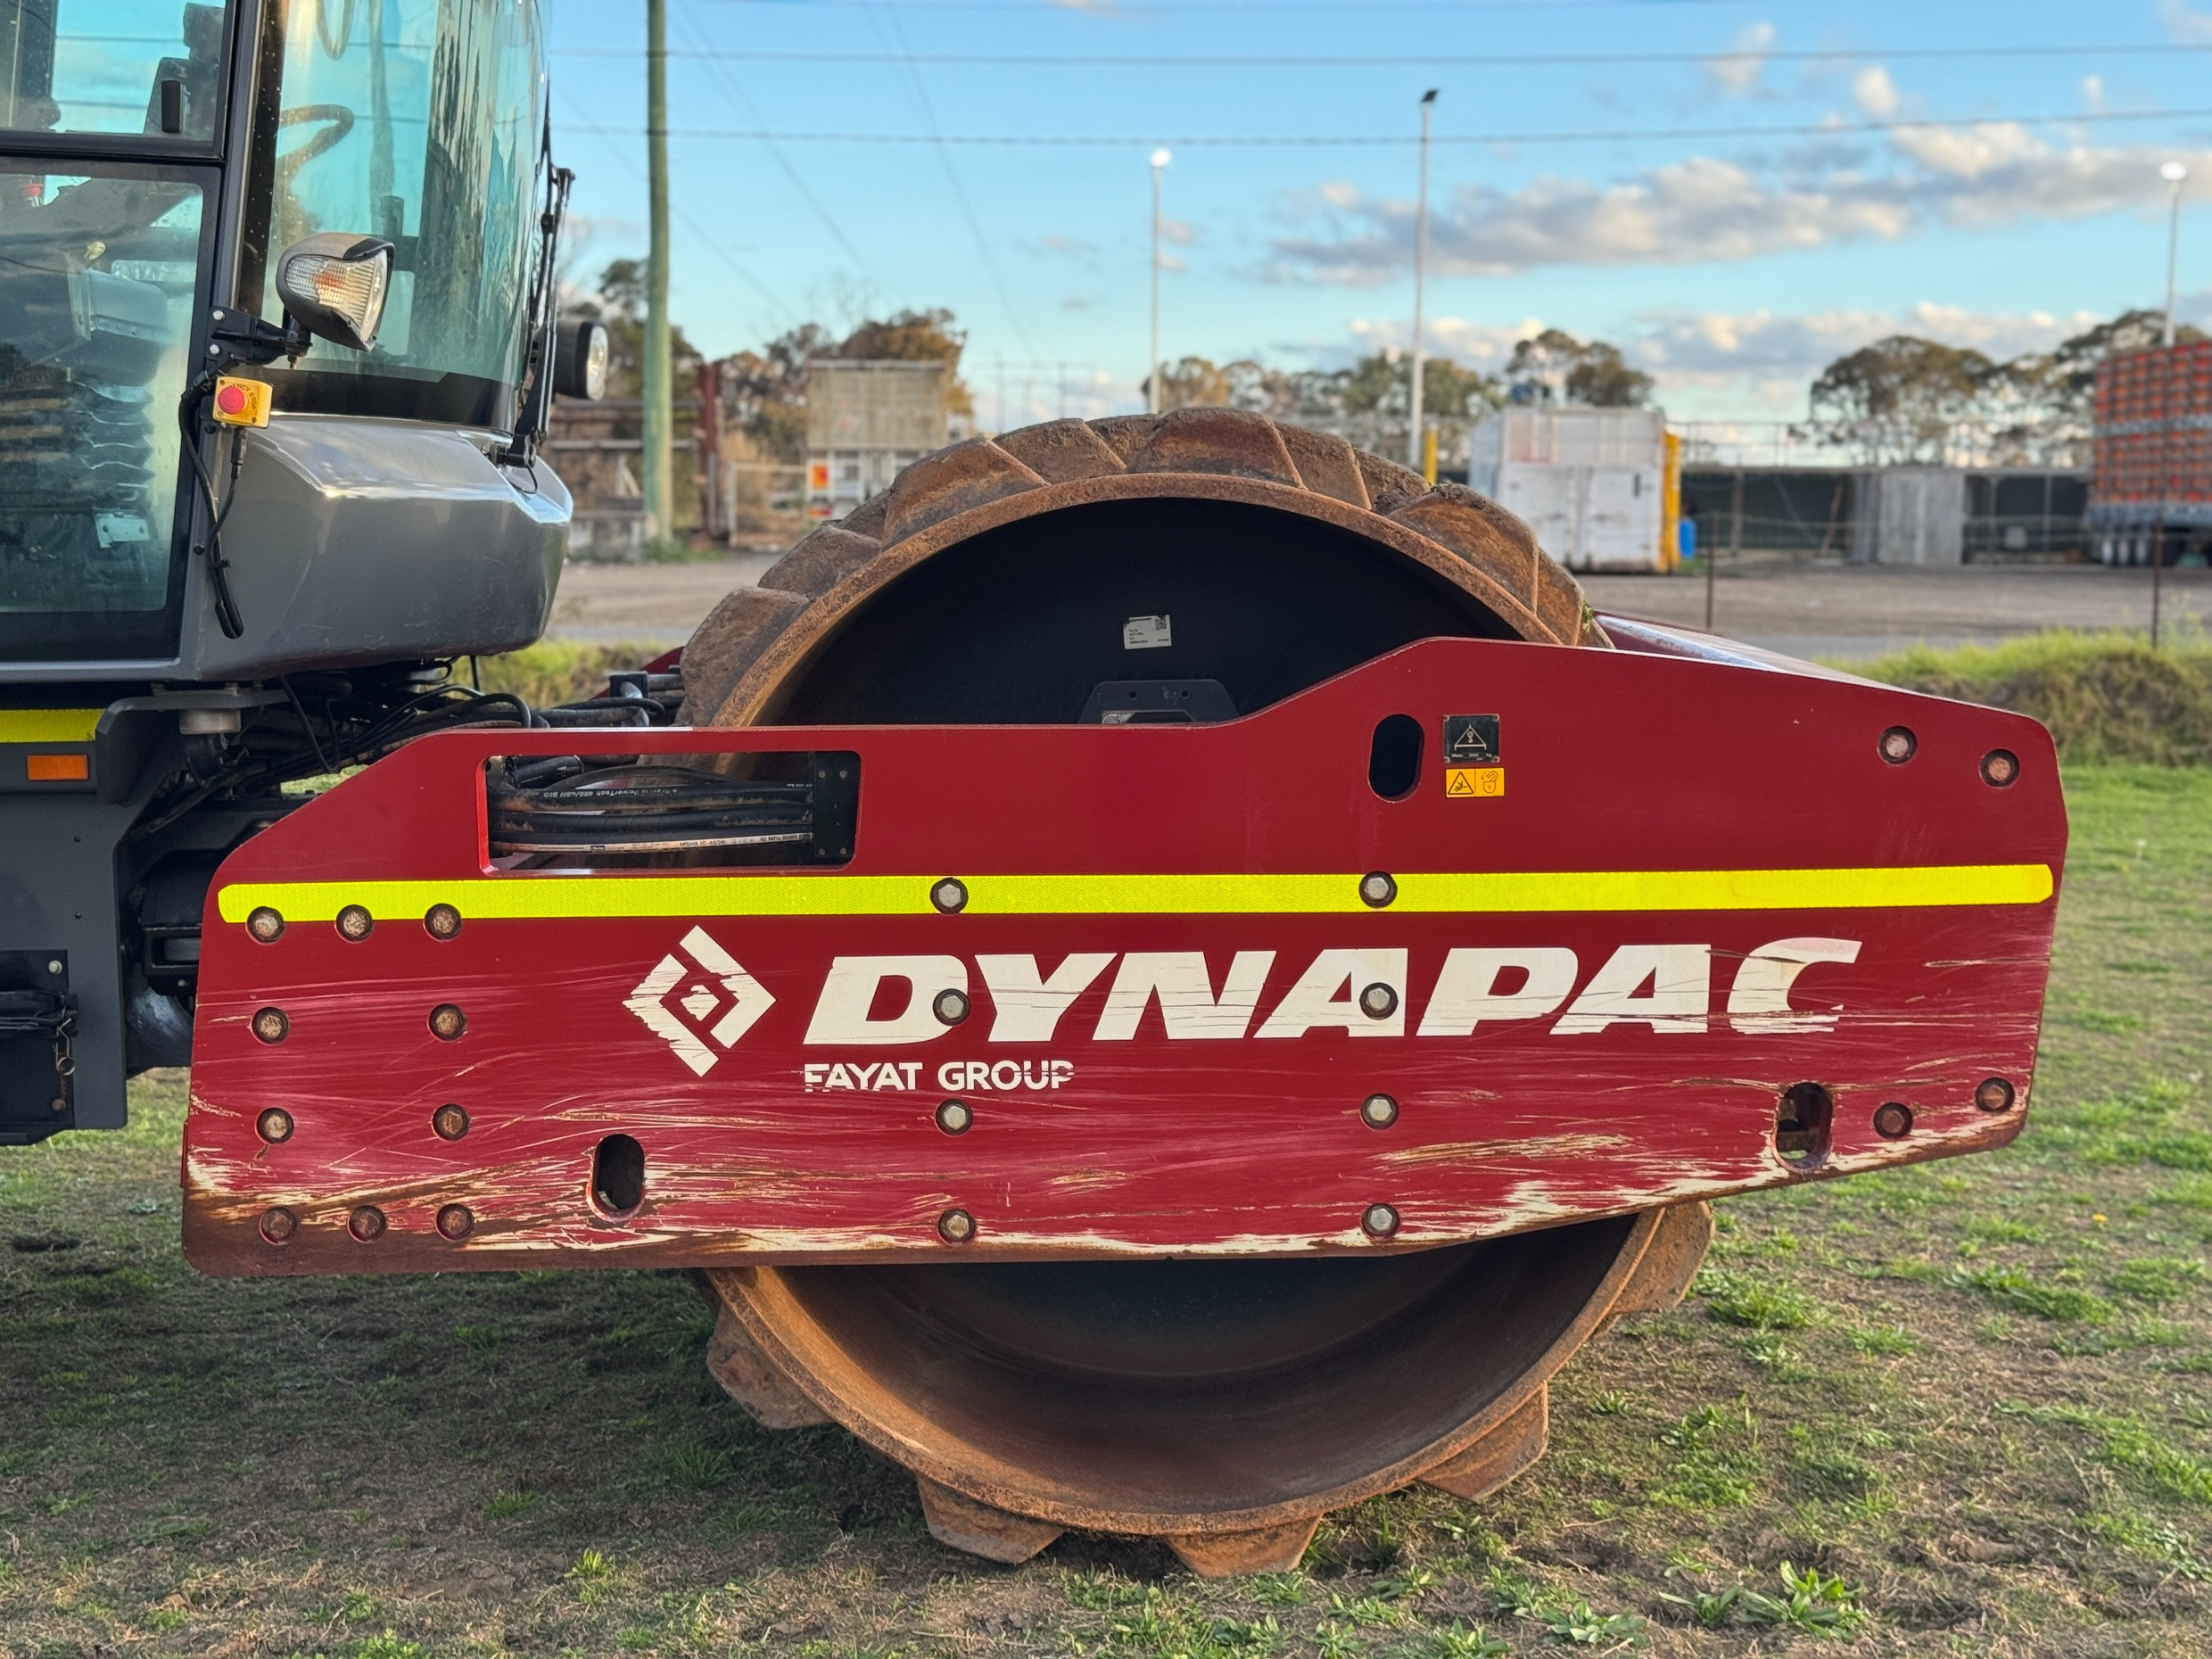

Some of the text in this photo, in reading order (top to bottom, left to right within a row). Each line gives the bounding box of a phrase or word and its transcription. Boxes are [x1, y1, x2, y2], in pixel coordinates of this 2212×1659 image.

[249, 392, 257, 409] STOP
[803, 937, 1862, 1044] DYNAPAC
[805, 1060, 1076, 1092] FAYAT GROUP
